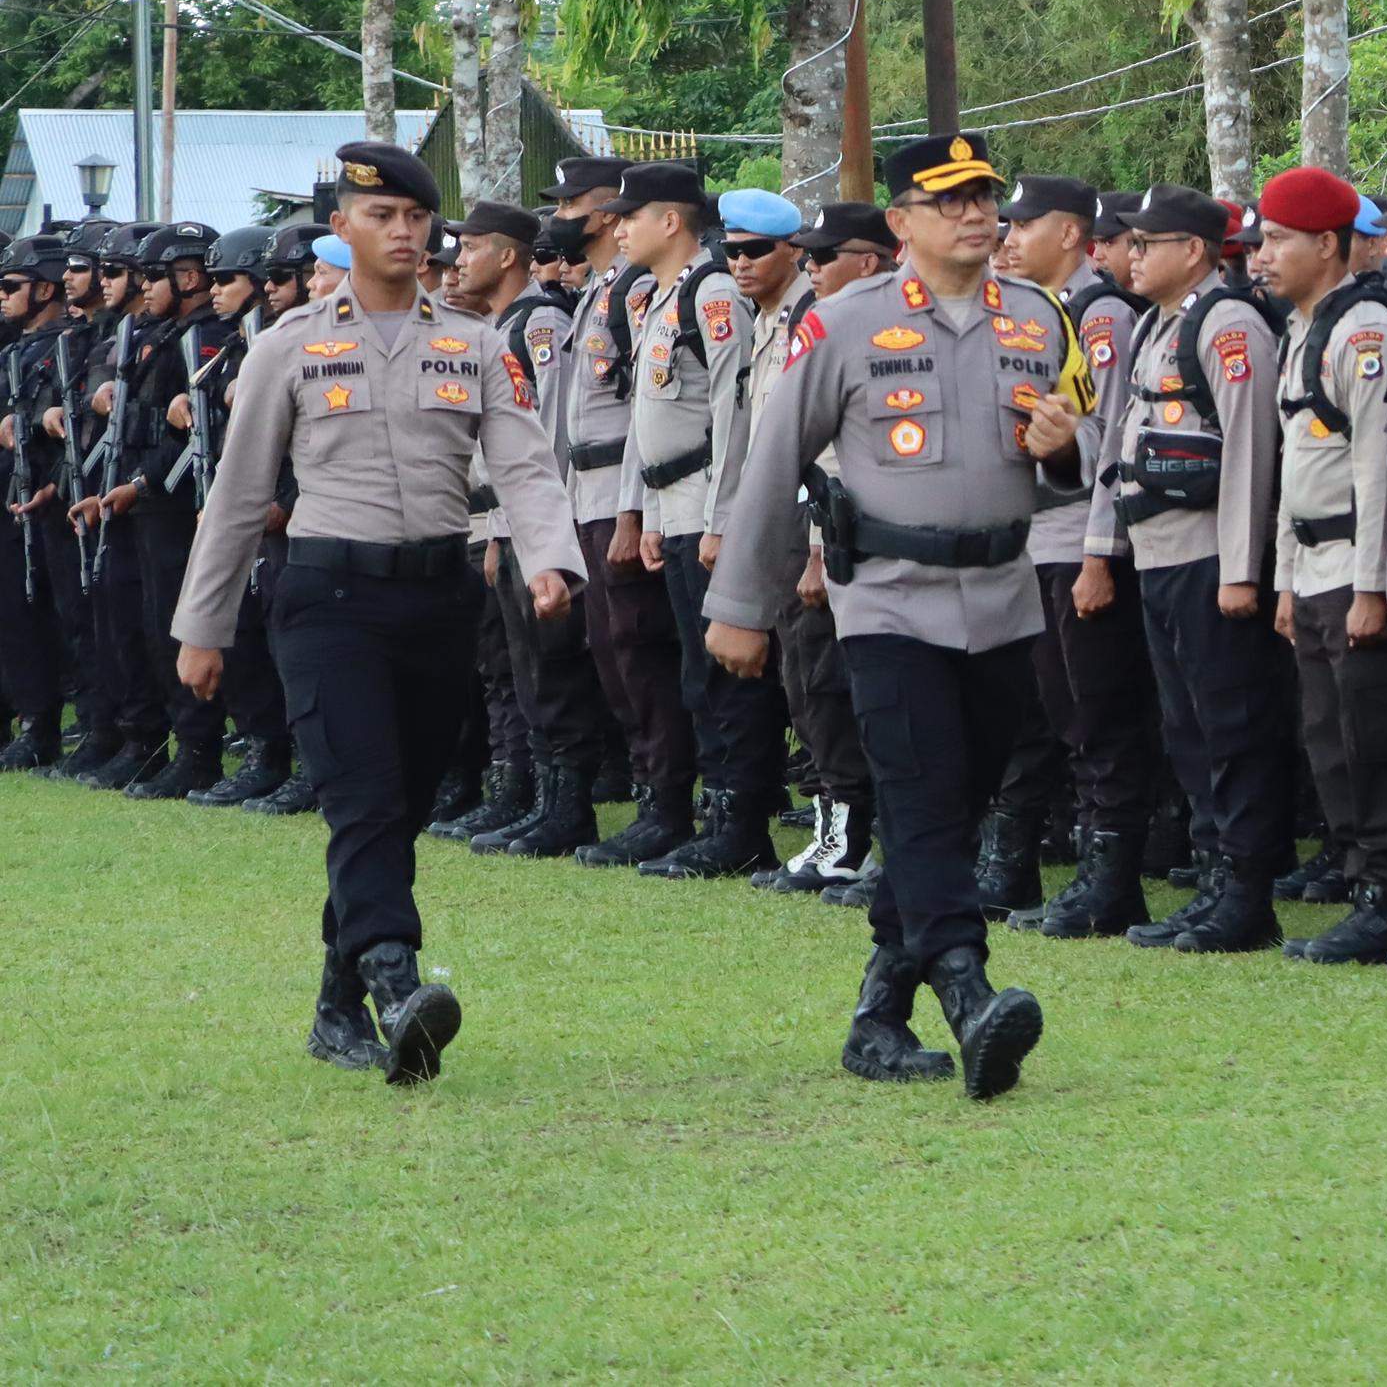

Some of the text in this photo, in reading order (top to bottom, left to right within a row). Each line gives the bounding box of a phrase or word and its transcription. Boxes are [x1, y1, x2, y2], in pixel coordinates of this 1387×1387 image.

[1083, 316, 1111, 330] POLDA
[421, 360, 478, 376] POLRI
[1000, 357, 1049, 377] POLRI
